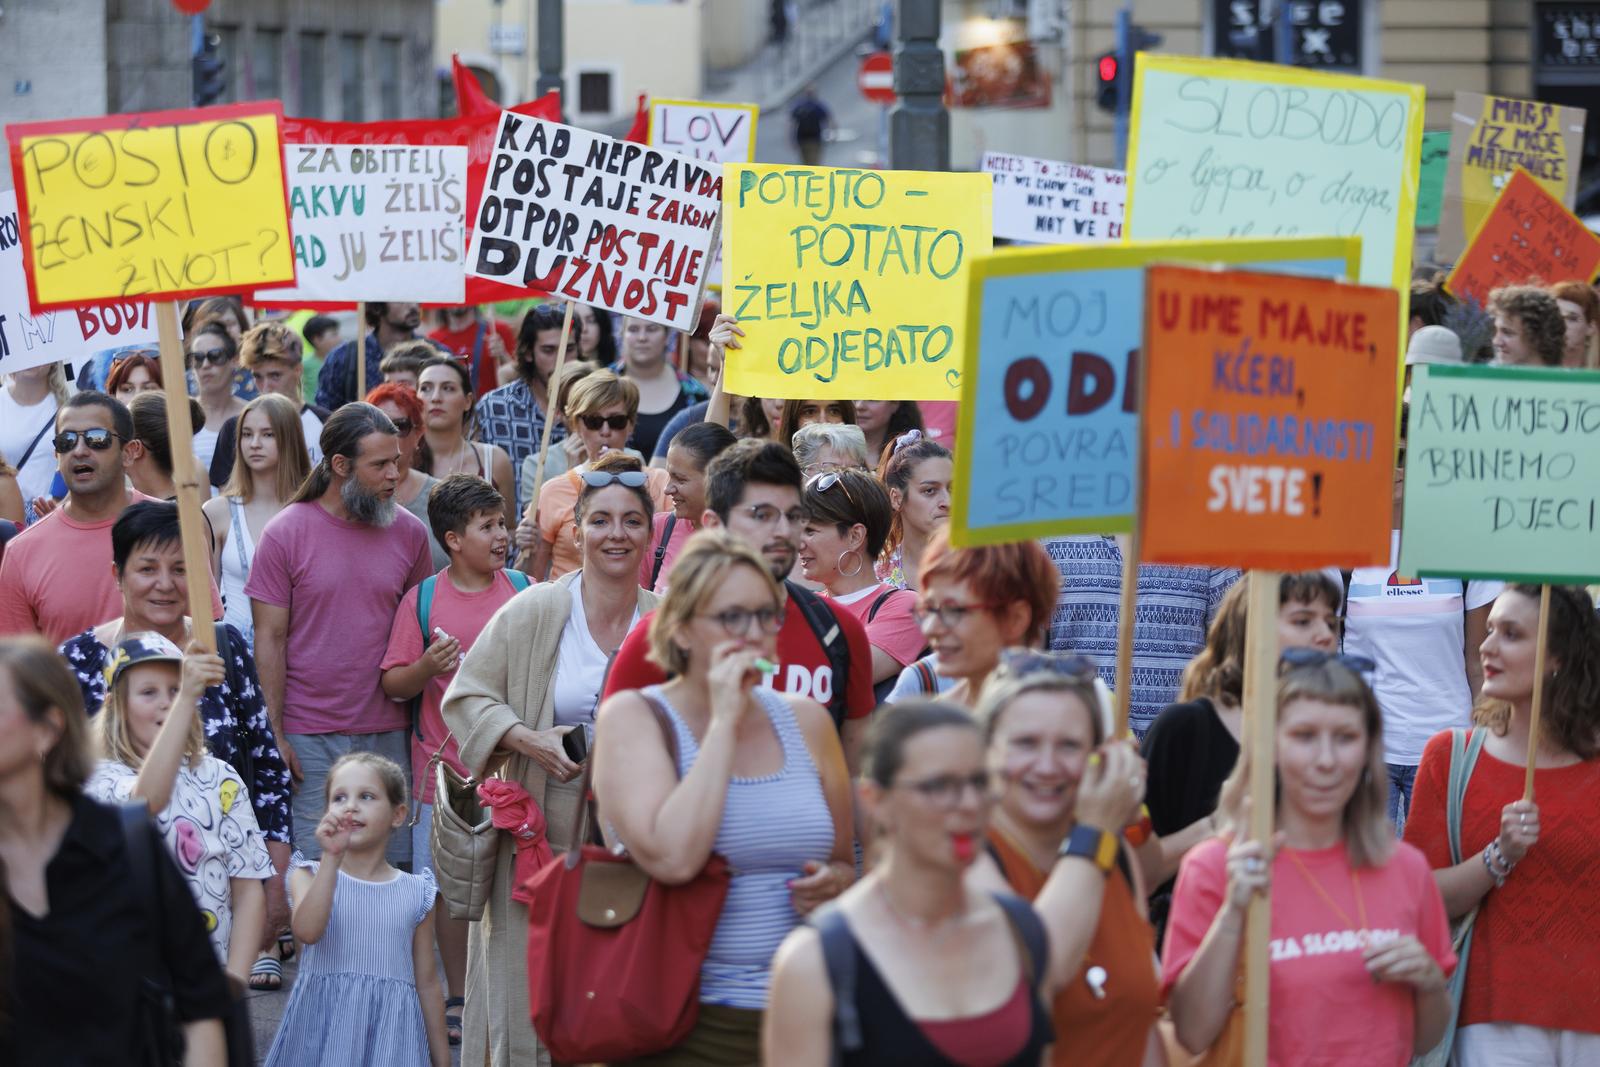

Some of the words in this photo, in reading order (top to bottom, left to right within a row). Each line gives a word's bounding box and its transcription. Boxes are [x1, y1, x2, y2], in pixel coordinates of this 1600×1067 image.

[297, 148, 341, 173] ZA
[498, 114, 571, 158] KAD
[585, 139, 723, 200] NEPRAVDA
[489, 153, 642, 216] POSTAJE
[646, 193, 717, 231] ZAKON
[740, 169, 886, 221] POTEJTO
[1027, 193, 1054, 210] MAY
[1062, 197, 1080, 212] WE
[1092, 200, 1109, 216] BE
[29, 192, 195, 270] ŽENSKI
[480, 195, 580, 252] OTPOR
[582, 219, 703, 287] POSTAJE
[1035, 215, 1065, 234] MAY
[1074, 218, 1096, 236] WE
[333, 231, 367, 281] JU
[790, 223, 964, 280] POTATO
[475, 236, 689, 321] DUŽNOST
[734, 273, 872, 330] ŽELJKA
[1001, 289, 1108, 340] MOJ
[1188, 295, 1244, 336] IME
[778, 325, 954, 383] ODJEBATO
[1419, 447, 1576, 488] BRINEMO
[1386, 587, 1424, 596] ellesse
[1269, 937, 1301, 961] ZA
